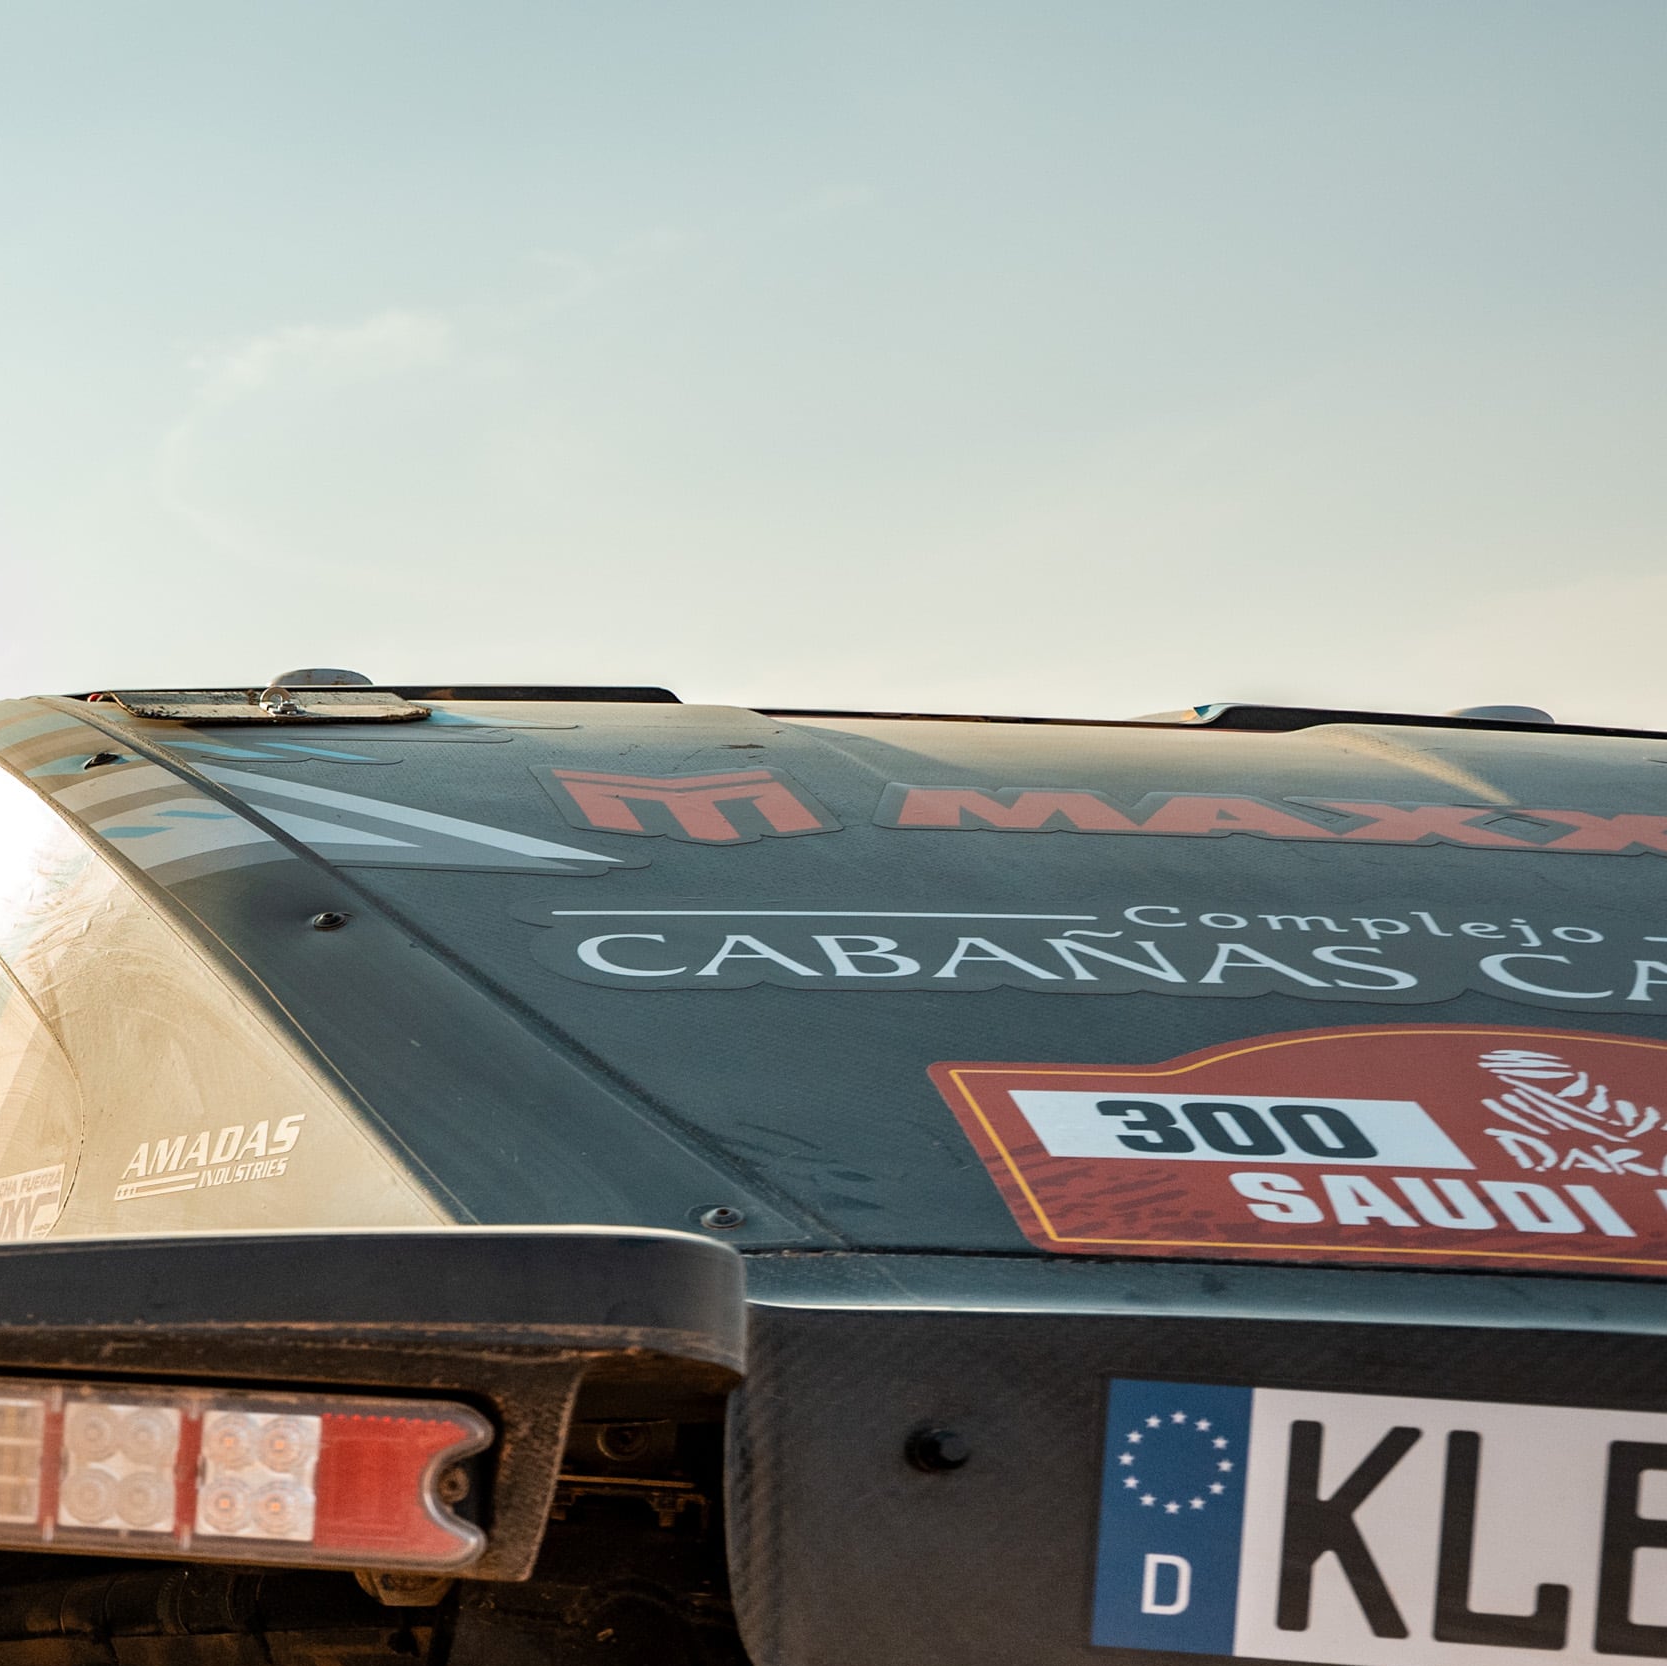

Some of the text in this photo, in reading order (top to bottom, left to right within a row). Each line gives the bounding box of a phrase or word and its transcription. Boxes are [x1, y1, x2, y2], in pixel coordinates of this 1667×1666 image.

[1123, 904, 1604, 947] Complejo
[575, 929, 1418, 991] CABAÑAS
[121, 1113, 306, 1179] AMADAS
[1096, 1100, 1379, 1159] 300
[198, 1157, 290, 1188] INDUSTRIES
[1228, 1171, 1637, 1237] SAUDI
[1140, 1553, 1192, 1615] D
